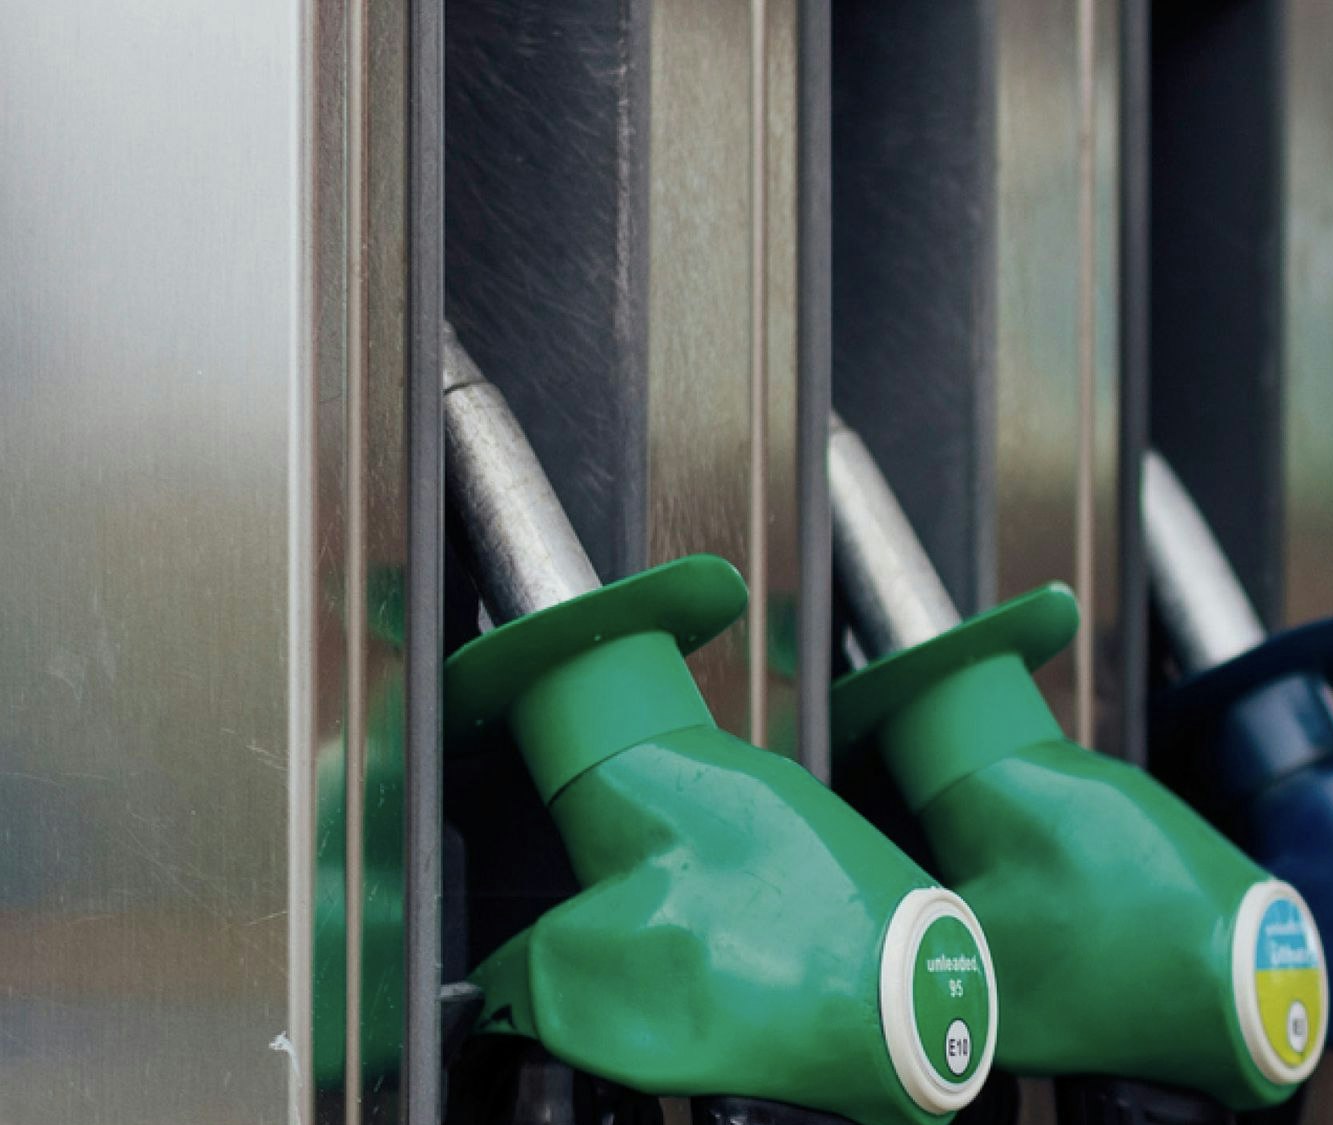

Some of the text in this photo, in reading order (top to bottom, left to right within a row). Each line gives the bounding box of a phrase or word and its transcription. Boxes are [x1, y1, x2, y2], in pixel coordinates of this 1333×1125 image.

[926, 954, 978, 973] unleaded
[948, 979, 964, 998] 95
[948, 1038, 969, 1057] E10
